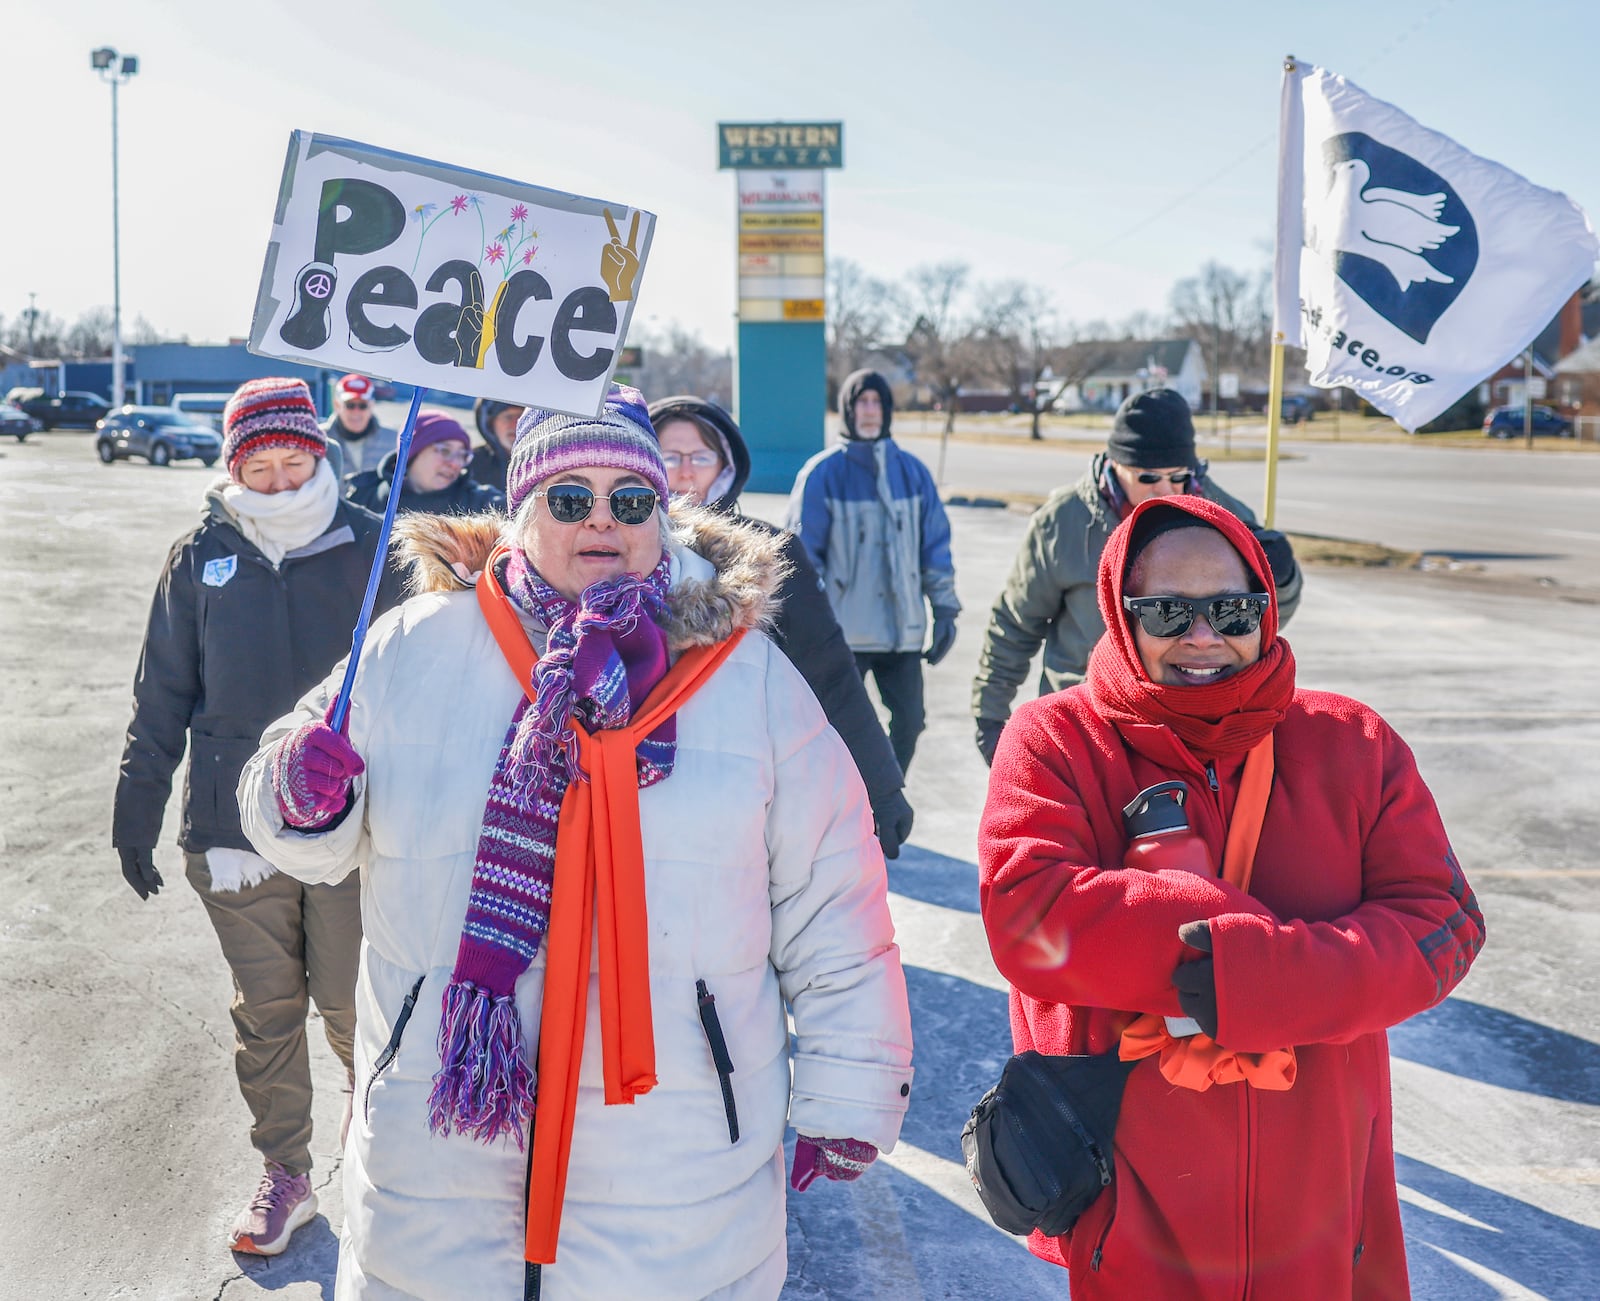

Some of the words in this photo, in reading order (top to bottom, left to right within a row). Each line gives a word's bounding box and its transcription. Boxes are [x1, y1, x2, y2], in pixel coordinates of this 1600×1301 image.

[725, 127, 837, 147] WESTERN
[729, 150, 832, 163] PLAZA
[279, 178, 616, 381] Peace
